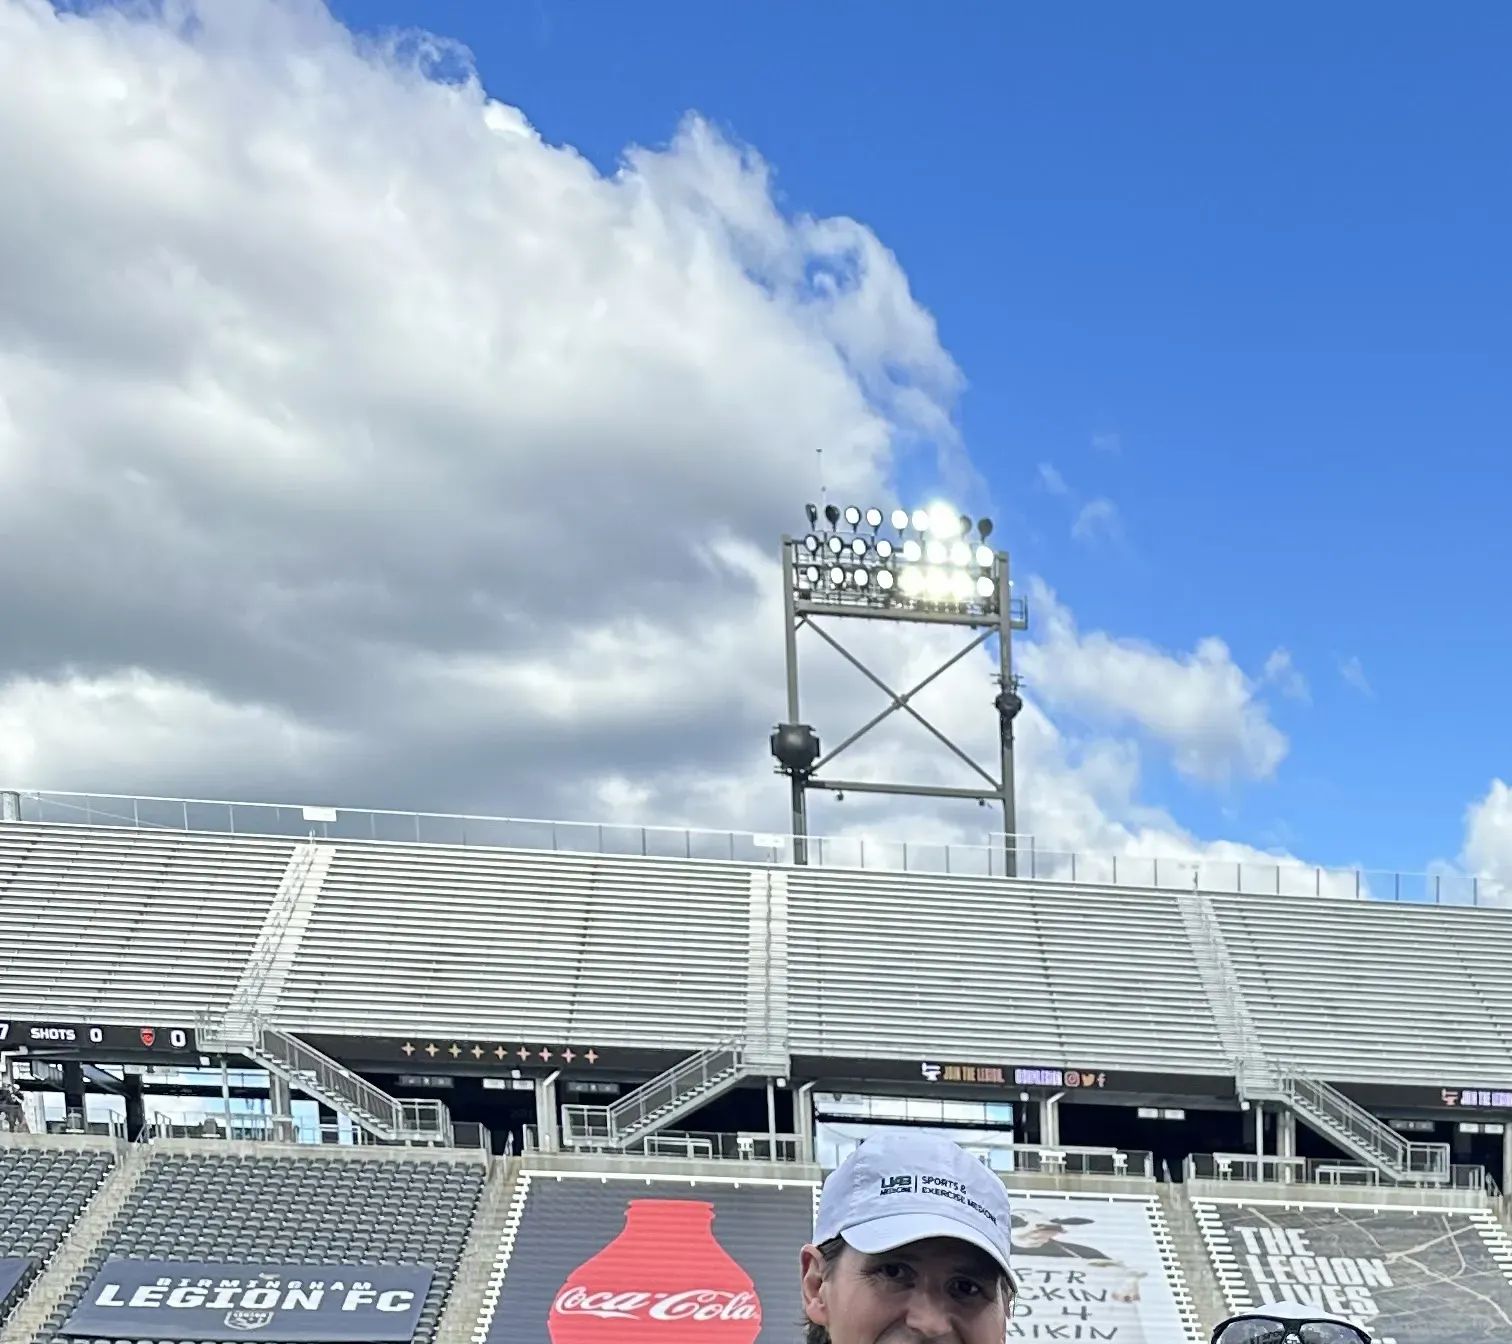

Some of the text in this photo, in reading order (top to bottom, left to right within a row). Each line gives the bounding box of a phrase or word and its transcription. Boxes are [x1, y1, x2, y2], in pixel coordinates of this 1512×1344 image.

[30, 1028, 76, 1040] SHOTS
[90, 1028, 103, 1043] 0
[171, 1030, 186, 1047] 0
[922, 1176, 967, 1194] SPORTS &
[922, 1187, 966, 1205] EXERCISE
[1234, 1227, 1315, 1256] THE
[1246, 1254, 1394, 1287] LEGION
[156, 1277, 372, 1291] BIRMINGHAM
[95, 1284, 415, 1312] LEGION FC
[556, 1286, 759, 1320] Coca-Cola
[1062, 1305, 1092, 1321] 4
